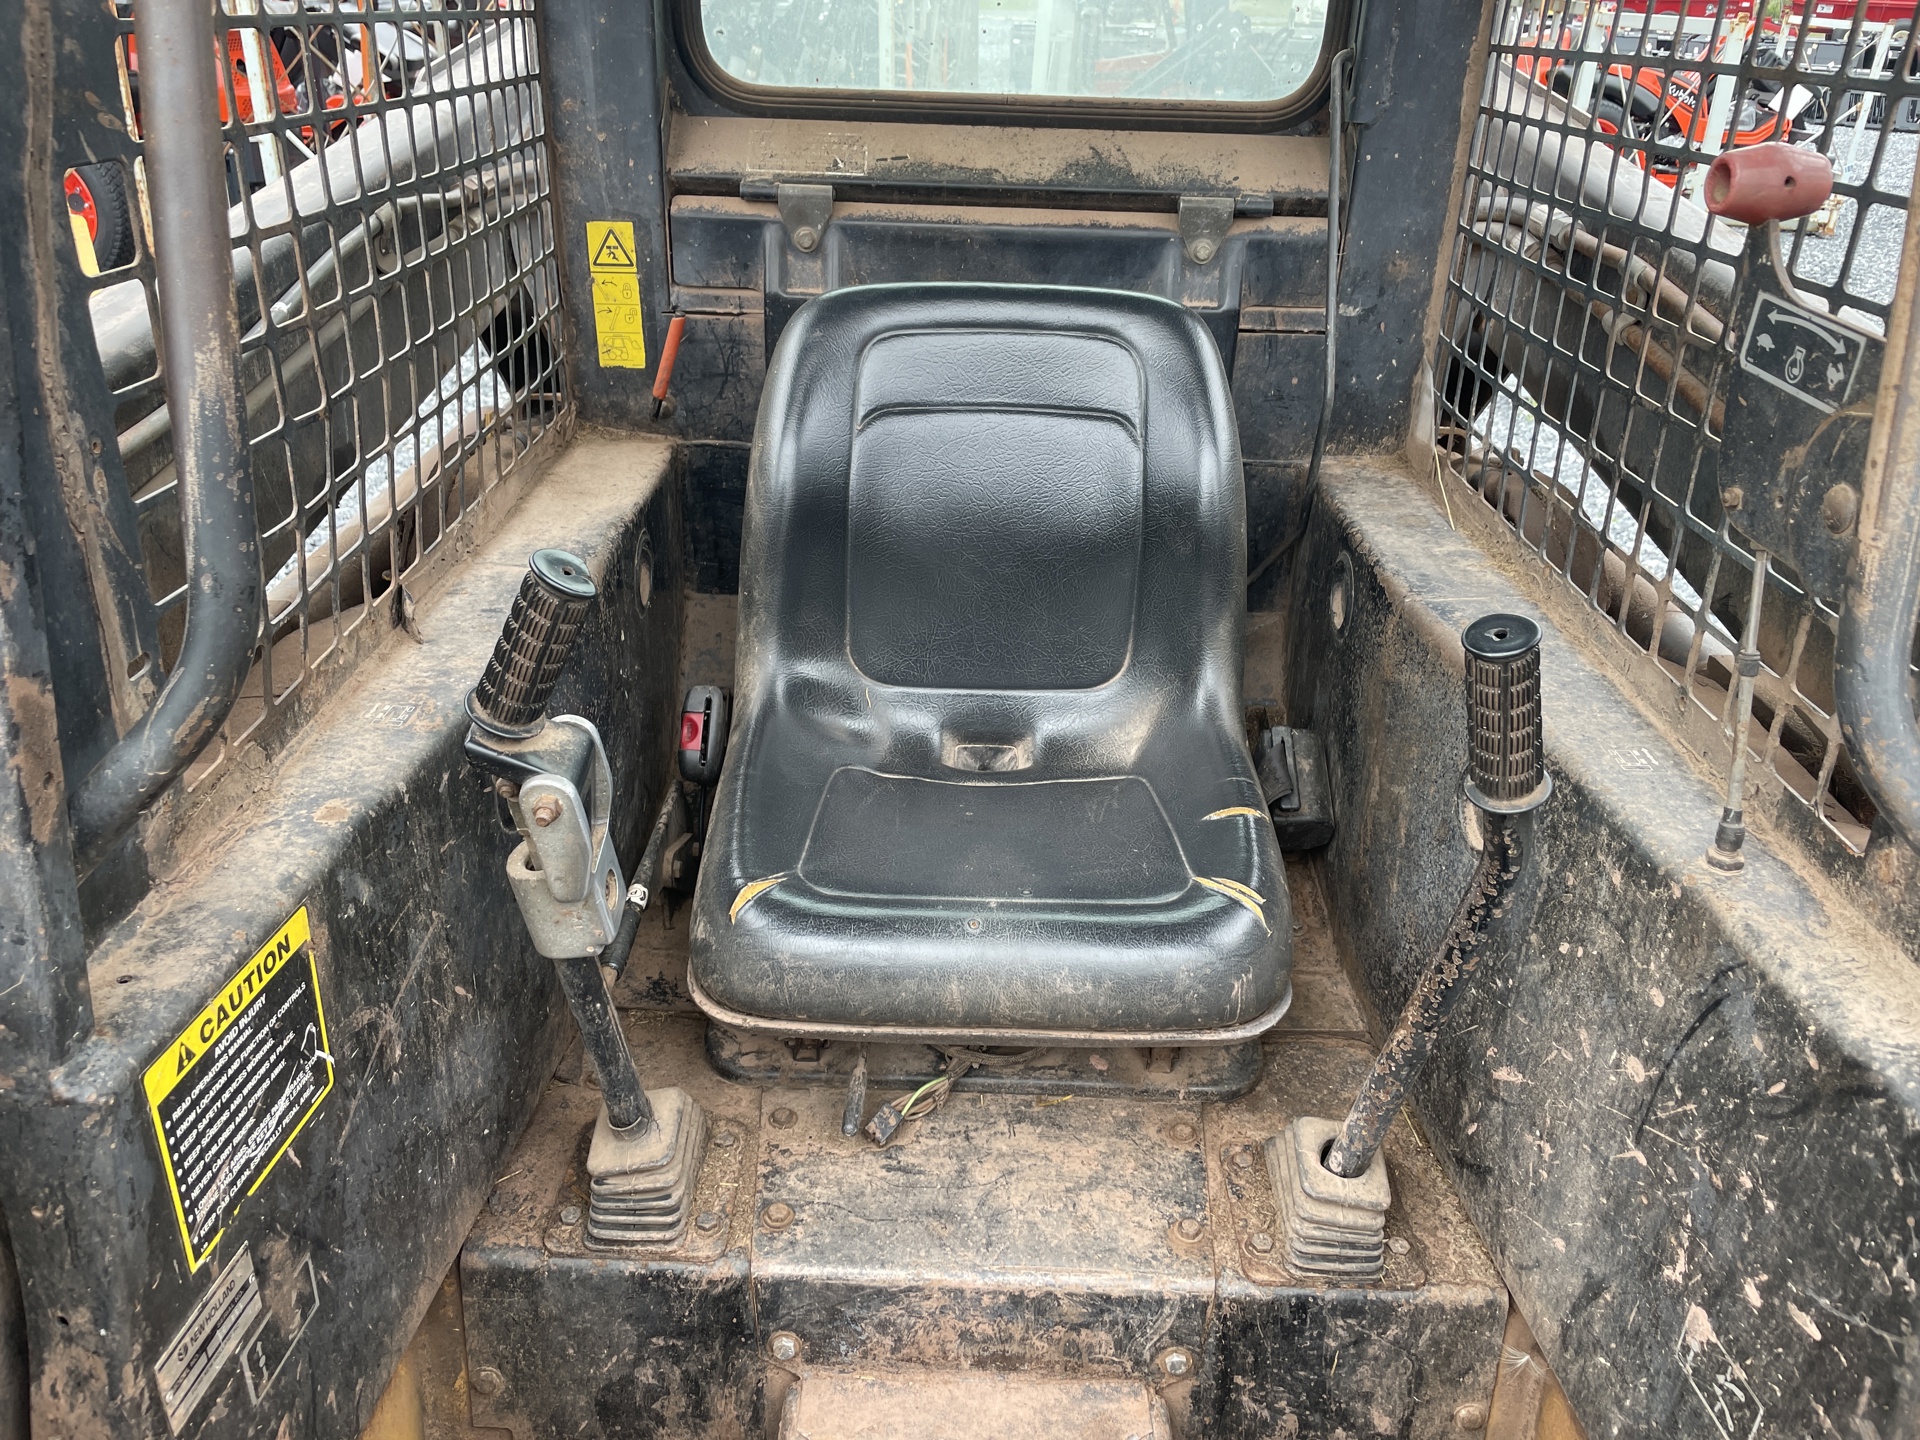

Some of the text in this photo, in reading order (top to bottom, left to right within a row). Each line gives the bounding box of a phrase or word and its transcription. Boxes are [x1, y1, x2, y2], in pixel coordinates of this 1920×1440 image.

[199, 933, 291, 1043] CAUTION
[214, 991, 266, 1059] AVOID INJURY
[171, 1026, 253, 1122] READ OPERATORS MANUAL
[175, 980, 306, 1139] KNOW LOCATION AND FUNCTION OF CONTROLS
[183, 1031, 295, 1171] KEEP SCREENS AND WINDOWS IN PLACE.
[179, 1126, 198, 1155] KEEP
[197, 1097, 222, 1133] SAFETY
[221, 1067, 247, 1104] DEVICES
[187, 1059, 286, 1186] KEEP CHILDREN AND OTHERS AWAY.
[247, 1111, 271, 1147] ENGAGE
[190, 1167, 213, 1201] NEVER
[211, 1141, 233, 1174] CARRY
[199, 1210, 217, 1238] KEEP
[216, 1193, 230, 1216] CAB
[250, 1123, 282, 1169] ESPECIALLY
[281, 1100, 300, 1129] PEDAL
[189, 1319, 205, 1347] NEW
[204, 1276, 236, 1326] HOLLAND
